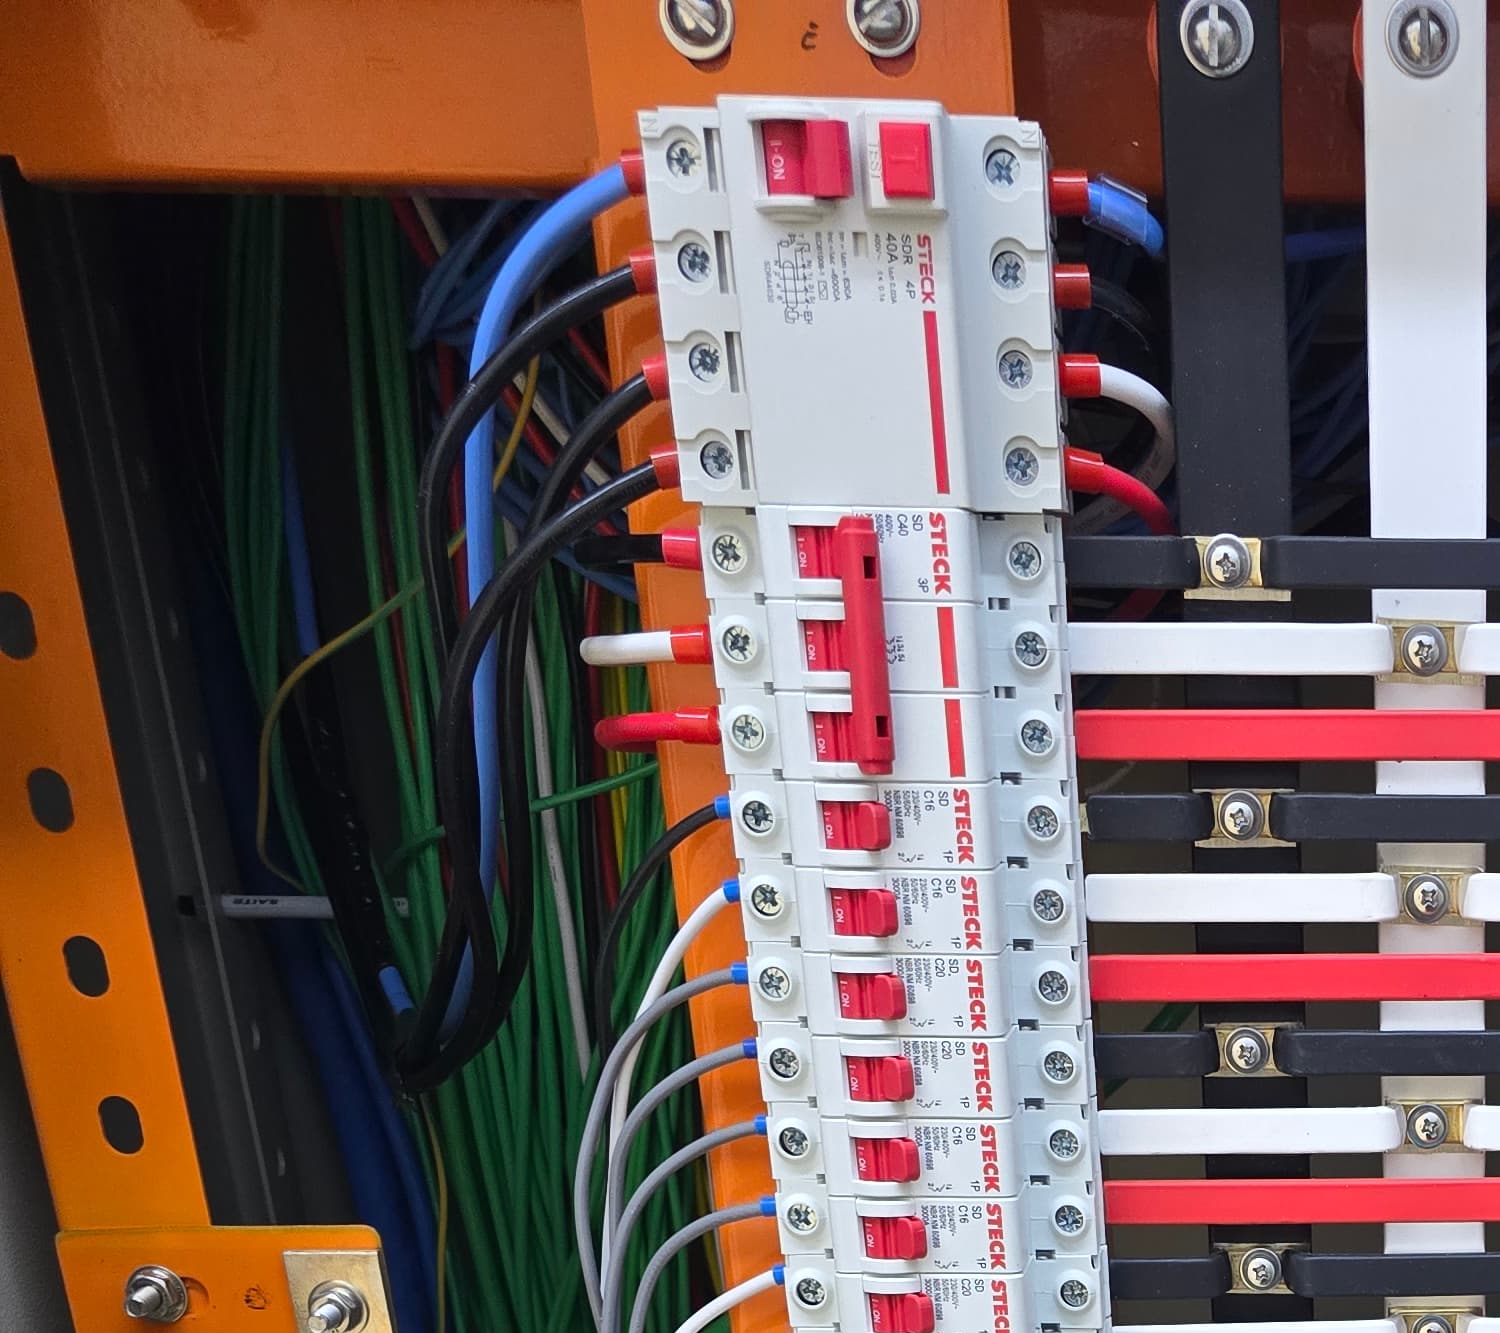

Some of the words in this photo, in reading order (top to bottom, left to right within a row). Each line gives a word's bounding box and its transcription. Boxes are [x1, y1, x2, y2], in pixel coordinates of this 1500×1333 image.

[885, 232, 899, 264] 40A
[901, 234, 913, 265] SDR
[917, 233, 936, 304] STECK
[905, 280, 916, 300] 4P
[897, 514, 908, 536] C40
[912, 515, 923, 531] SD
[918, 578, 929, 592] 3P
[928, 512, 951, 594] STECK
[924, 791, 935, 811] C16
[938, 791, 949, 806] SD
[944, 851, 953, 863] 1P
[953, 789, 974, 862] STECK
[931, 878, 942, 898] C16
[945, 879, 956, 893] SD
[951, 937, 961, 948] 1P
[961, 877, 981, 949] STECK
[935, 958, 945, 977] C20
[949, 959, 959, 973] SD
[954, 1016, 963, 1027] 1P
[966, 959, 987, 1030] STECK
[941, 1041, 952, 1059] C20
[955, 1042, 965, 1055] SD
[960, 1097, 971, 1108] 1P
[971, 1043, 993, 1111] STECK
[952, 1127, 962, 1145] C16
[966, 1127, 976, 1141] SD
[971, 1181, 980, 1191] 1P
[980, 1125, 999, 1192] STECK
[959, 1205, 969, 1223] C16
[972, 1206, 982, 1219] SD
[977, 1258, 986, 1268] 1P
[986, 1204, 1006, 1269] STECK
[961, 1279, 971, 1296] C20
[975, 1279, 984, 1292] SD
